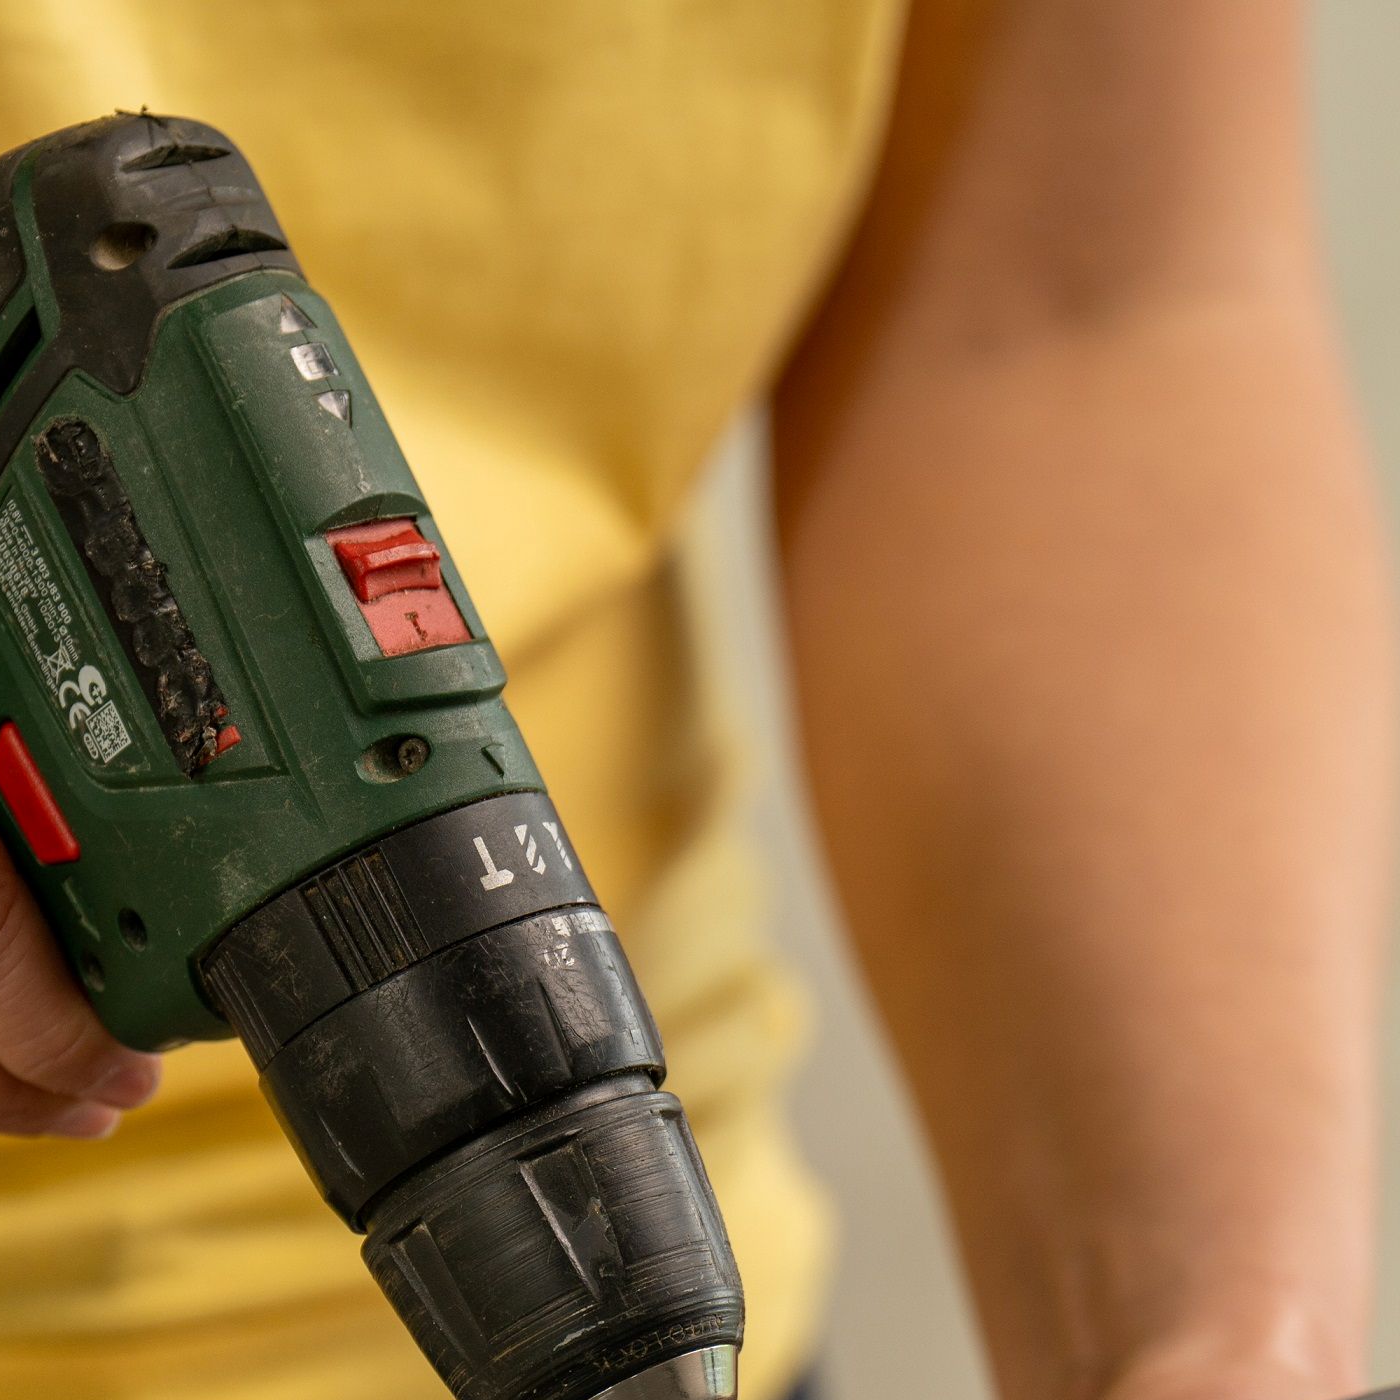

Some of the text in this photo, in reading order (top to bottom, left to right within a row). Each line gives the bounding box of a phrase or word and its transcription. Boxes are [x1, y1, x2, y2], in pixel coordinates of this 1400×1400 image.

[4, 571, 22, 602] Bosch
[19, 603, 38, 633] GmbH
[10, 545, 19, 556] in
[15, 557, 38, 596] Hungary
[36, 599, 61, 642] 10/2013
[29, 546, 39, 556] 3
[34, 556, 50, 579] 603
[45, 581, 61, 602] J83
[56, 602, 72, 624] 900
